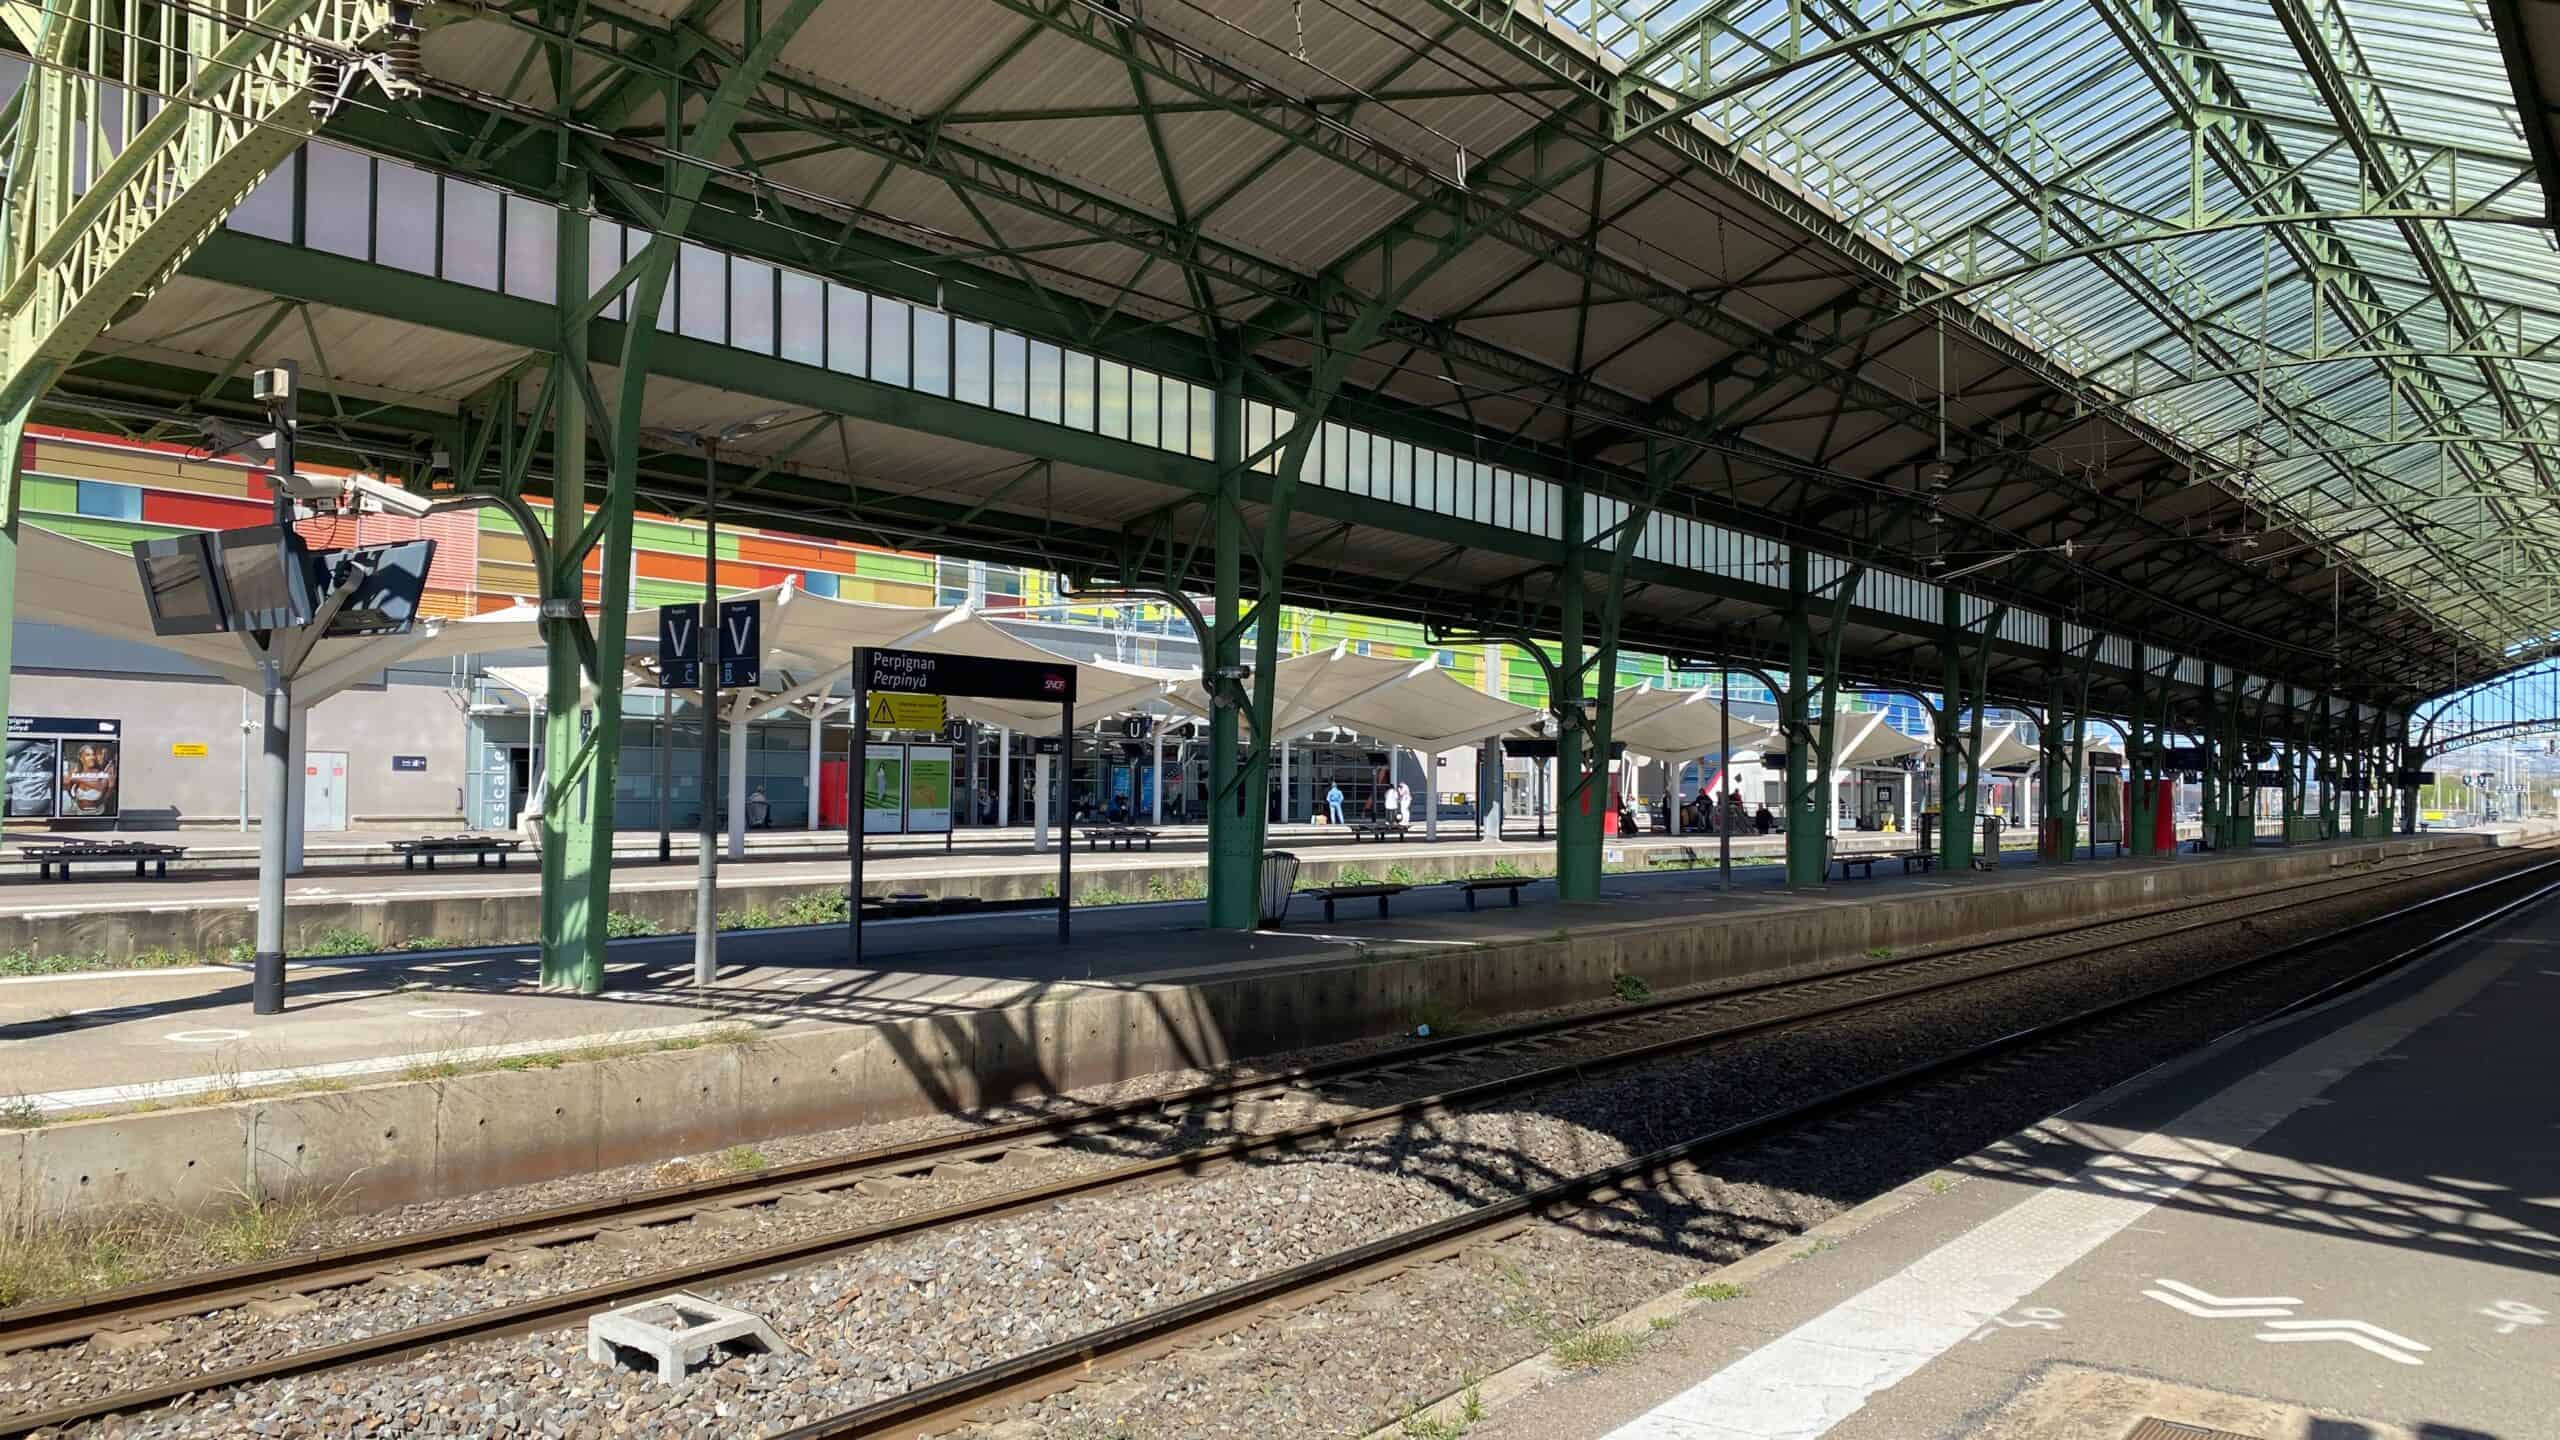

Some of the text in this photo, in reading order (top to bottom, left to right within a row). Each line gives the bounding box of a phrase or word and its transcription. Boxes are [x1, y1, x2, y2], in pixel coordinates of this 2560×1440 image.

[668, 618, 691, 656] V
[728, 616, 751, 655] V
[873, 651, 936, 673] Perpignan
[873, 669, 927, 690] Perpinyà
[1044, 679, 1065, 689] SNCF
[953, 724, 962, 740] U
[1130, 721, 1140, 738] U
[492, 749, 505, 827] escale
